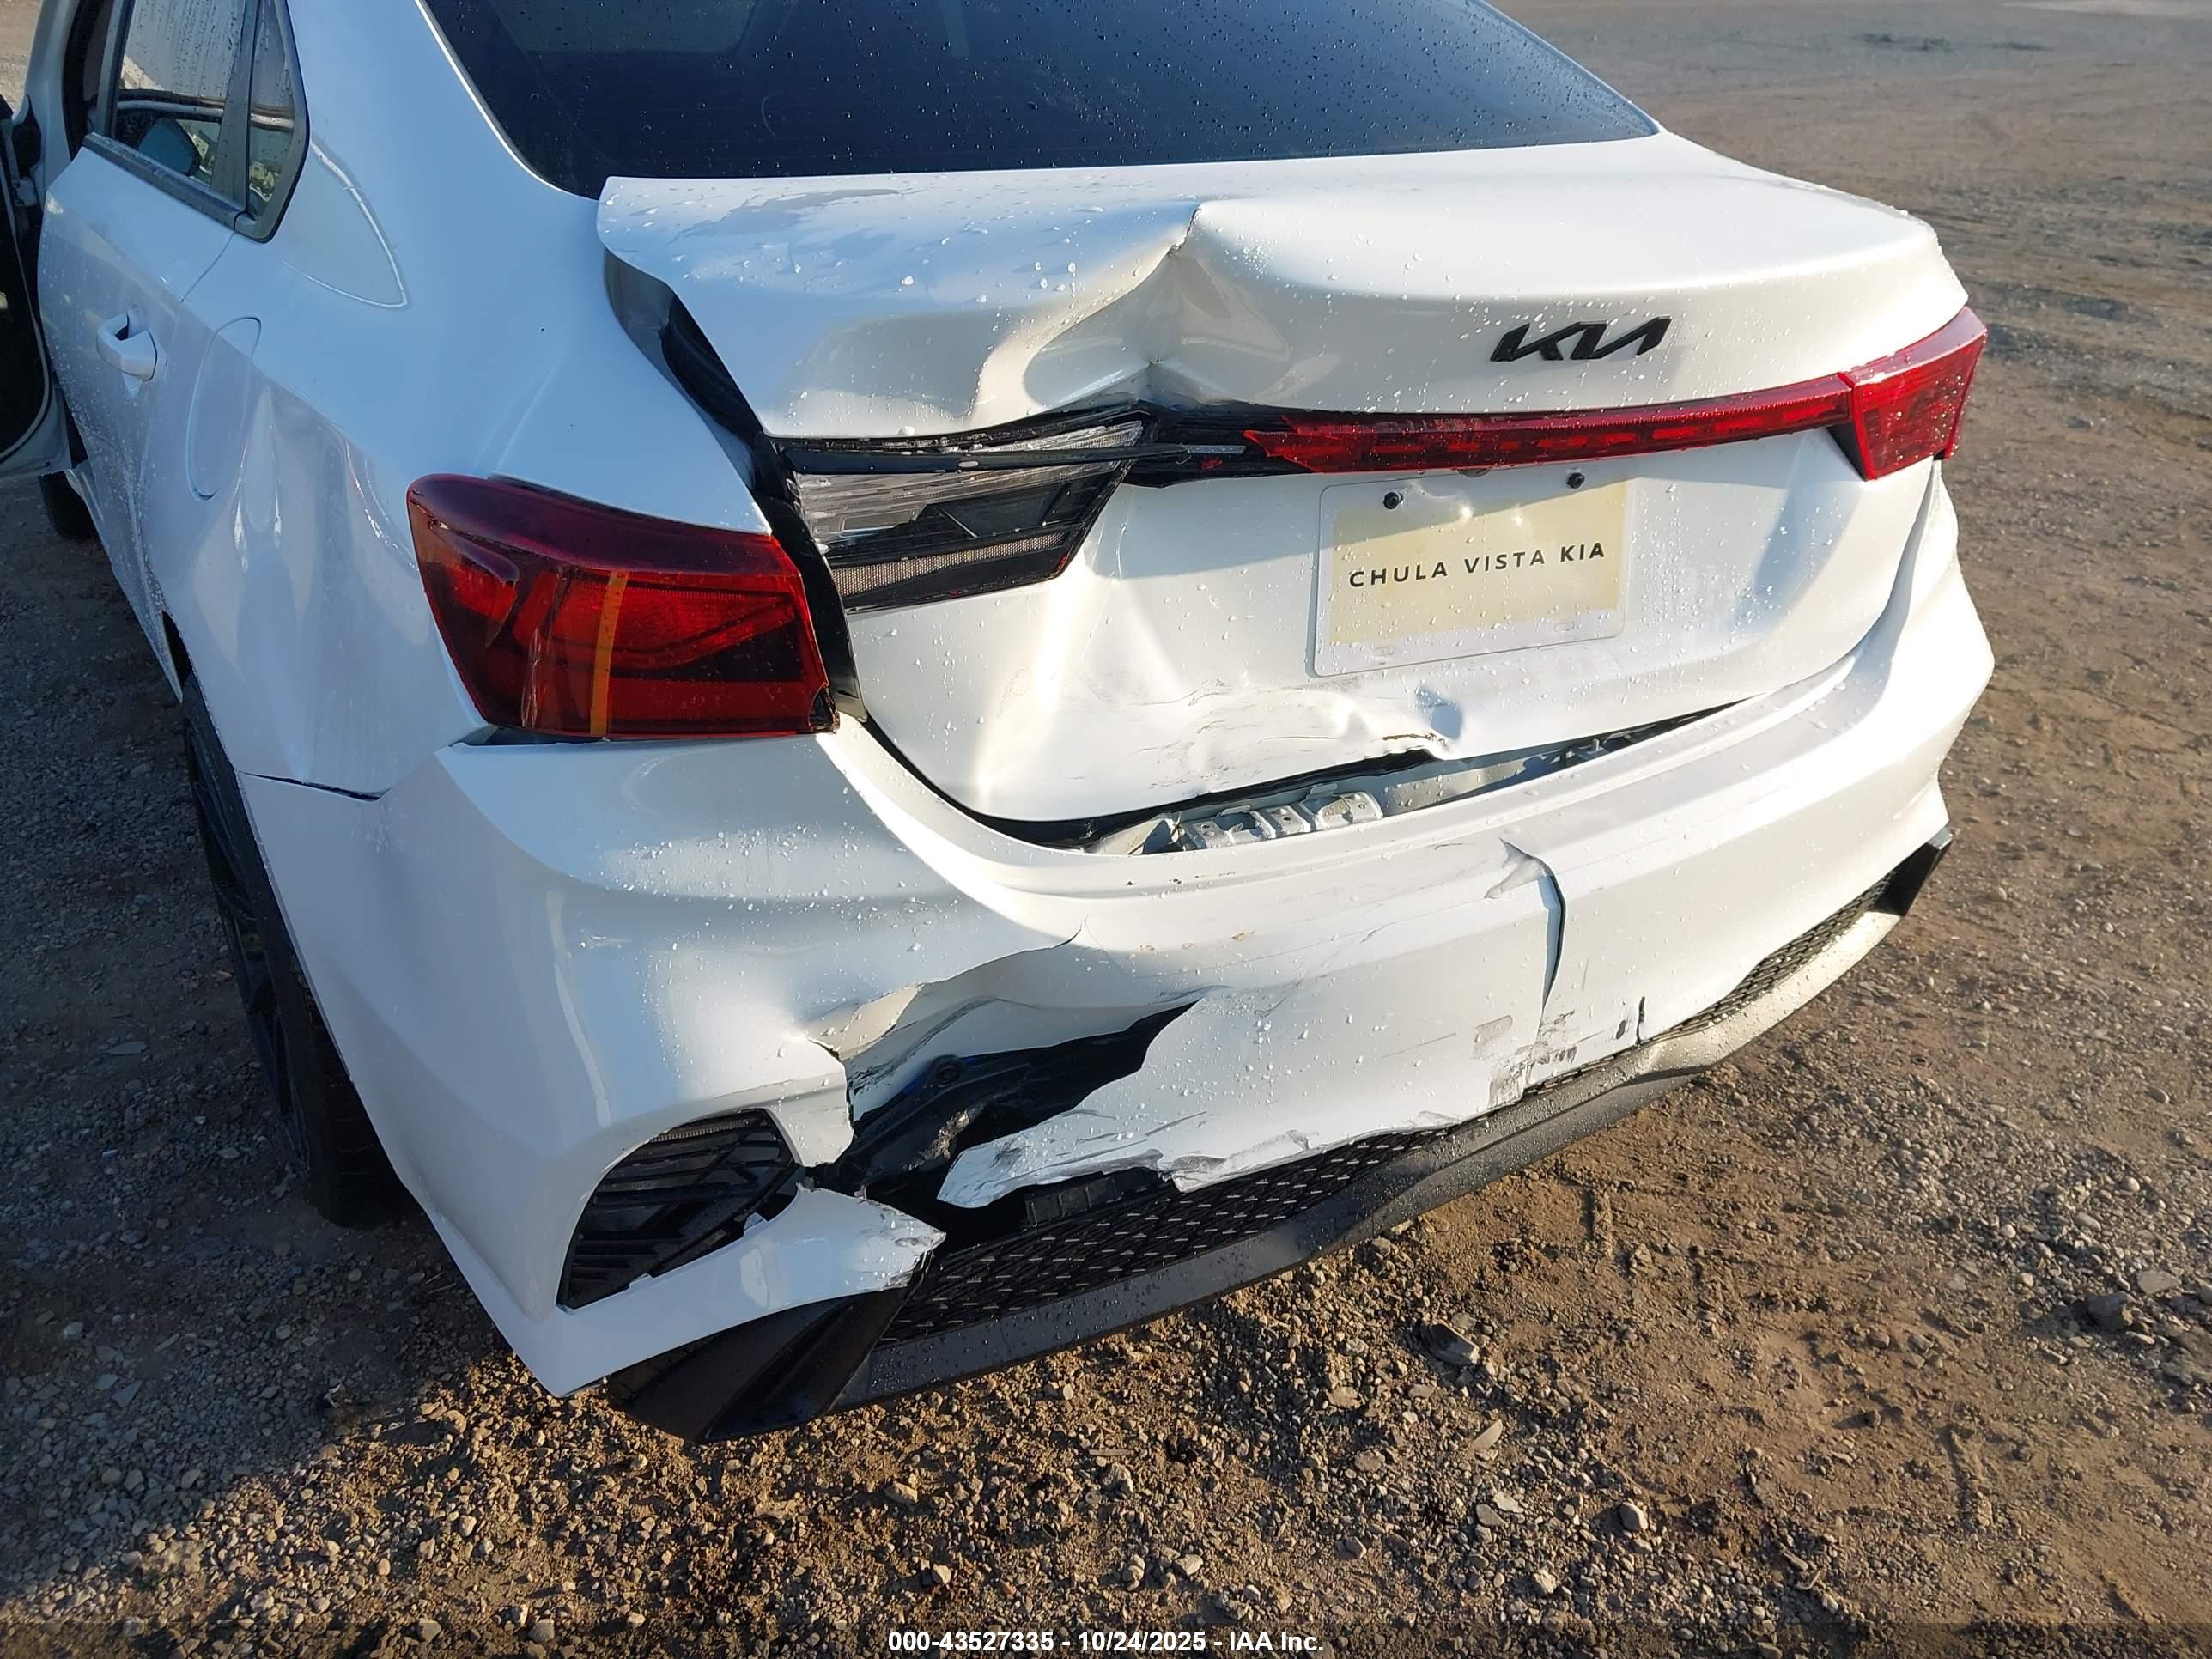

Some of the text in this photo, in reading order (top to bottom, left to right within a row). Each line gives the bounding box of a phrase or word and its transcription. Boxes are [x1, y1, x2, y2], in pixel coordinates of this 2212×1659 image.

[1490, 316, 1672, 362] KIA
[1349, 542, 1605, 587] CHULA VISTA KIA
